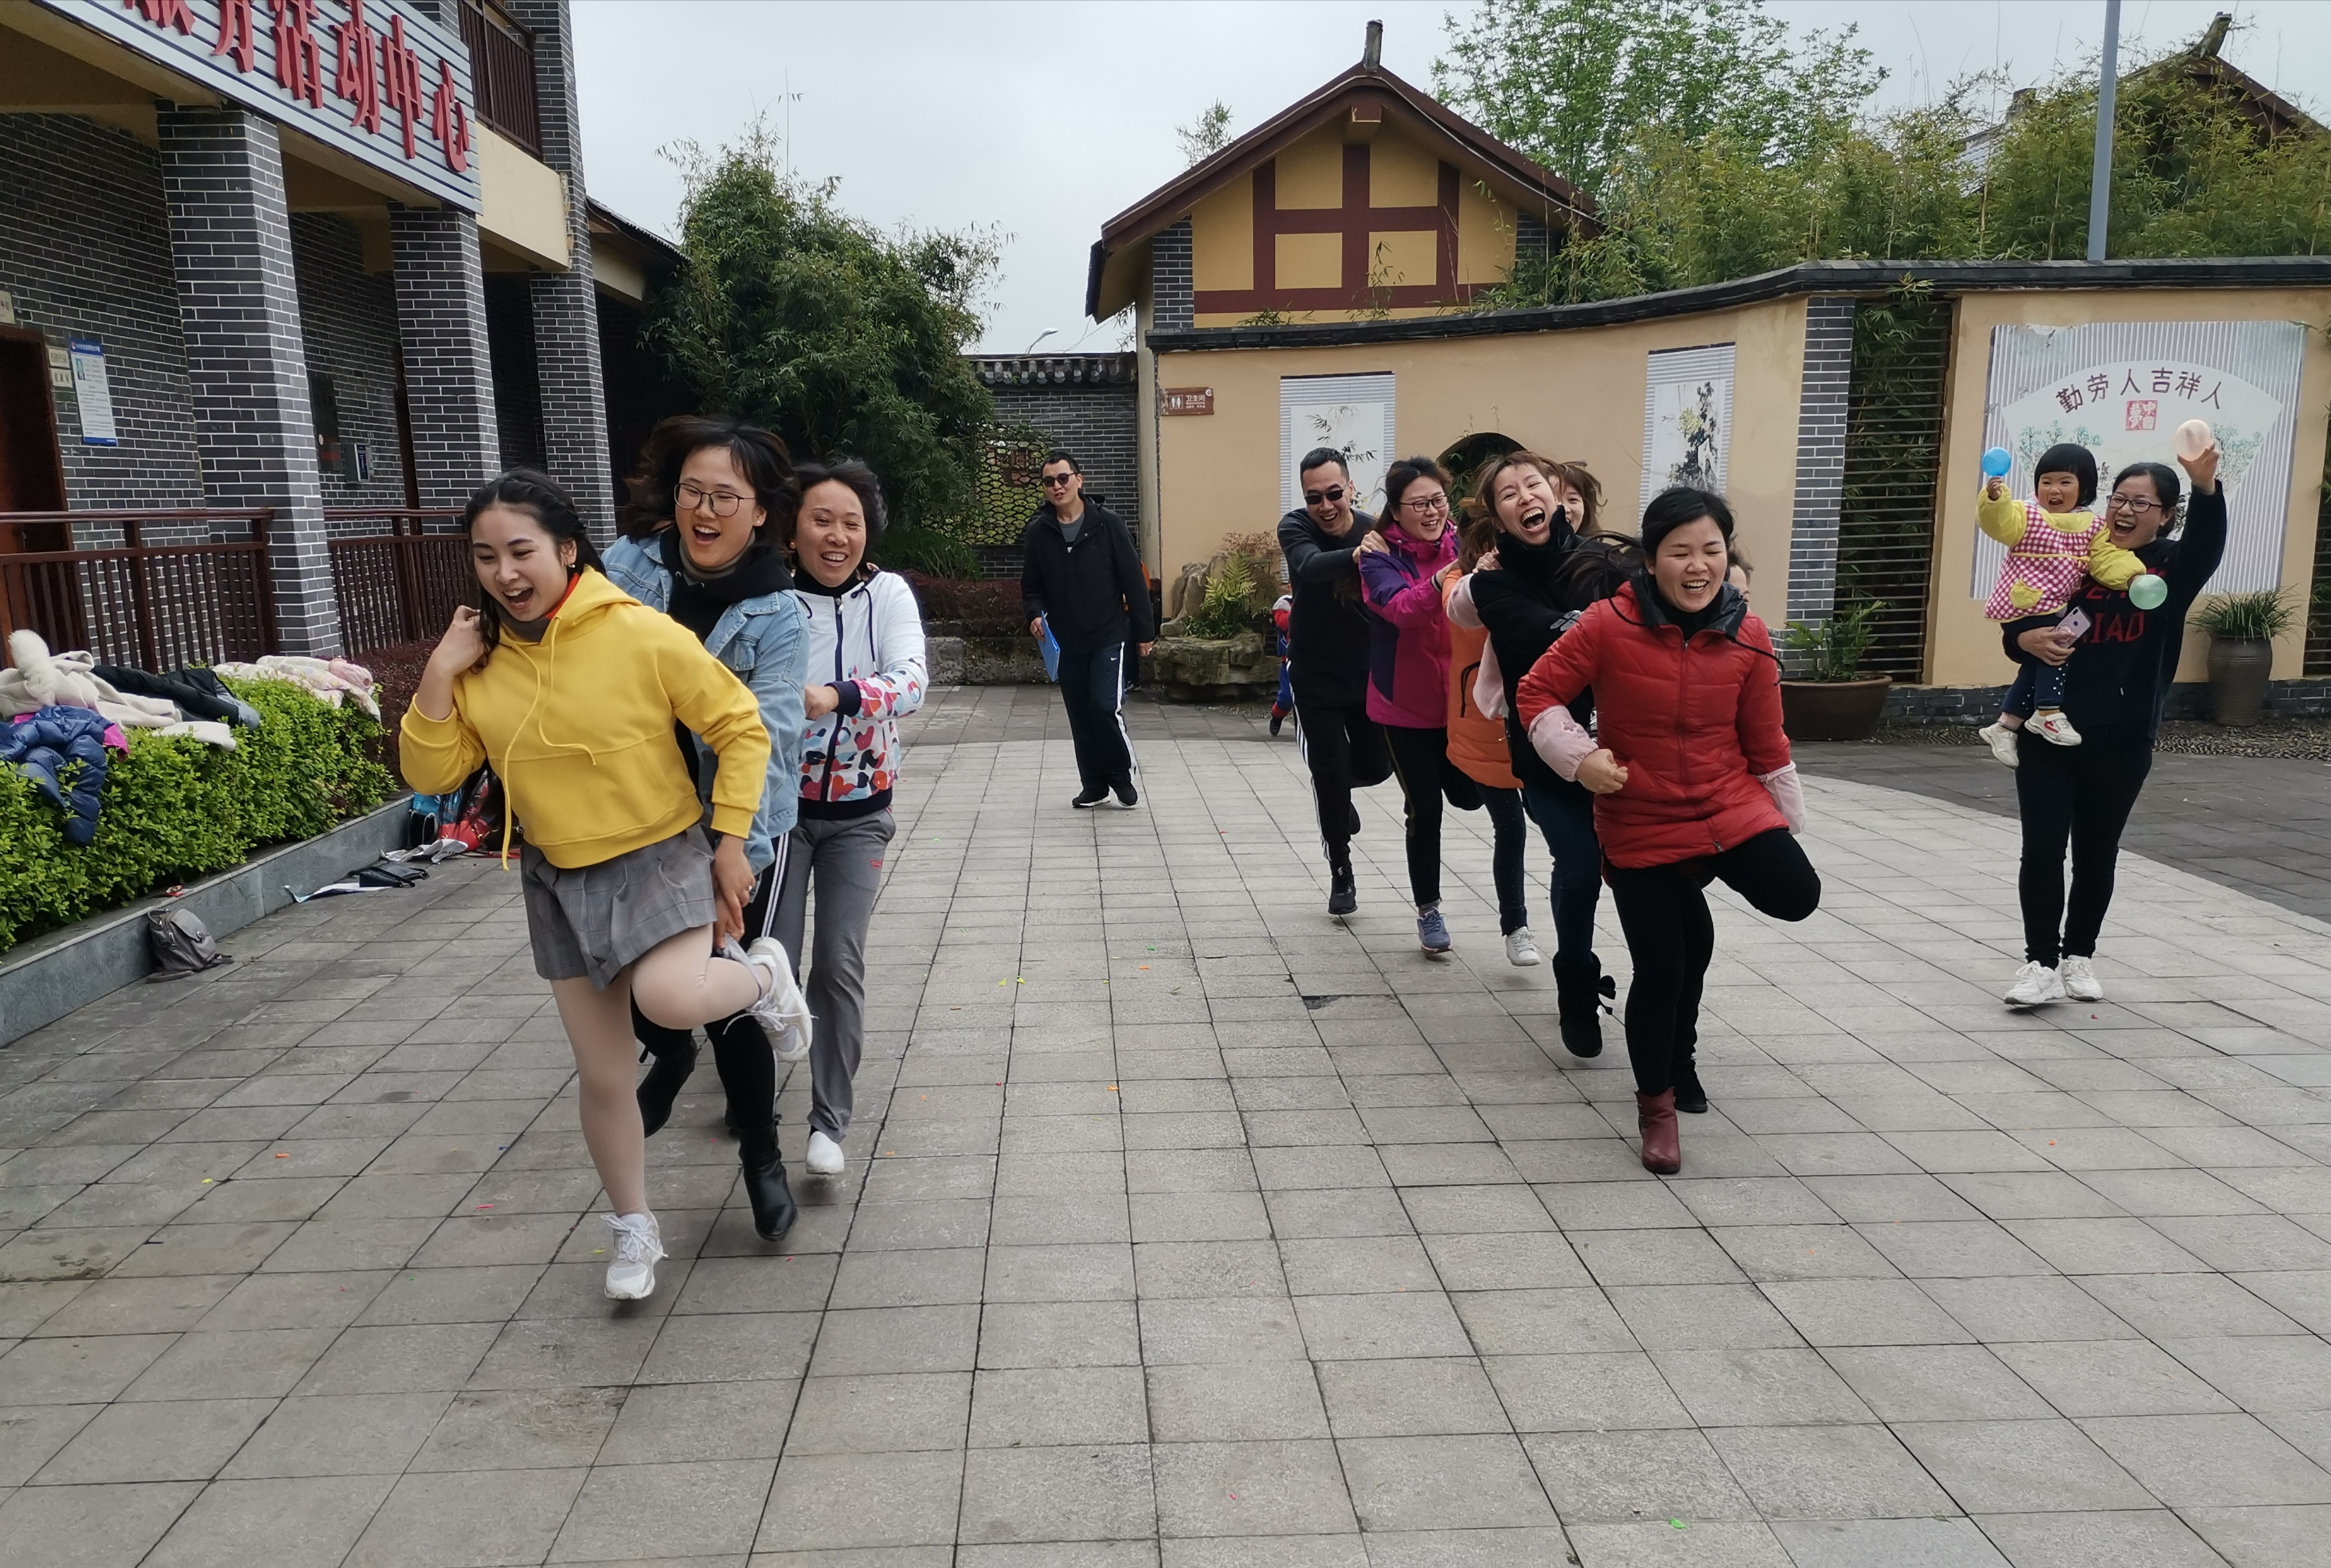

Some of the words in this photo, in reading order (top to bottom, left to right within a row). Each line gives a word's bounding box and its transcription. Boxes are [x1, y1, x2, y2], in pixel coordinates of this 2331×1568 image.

[124, 0, 470, 173] 活动中心
[2055, 367, 2222, 413] 勤劳人吉祥人
